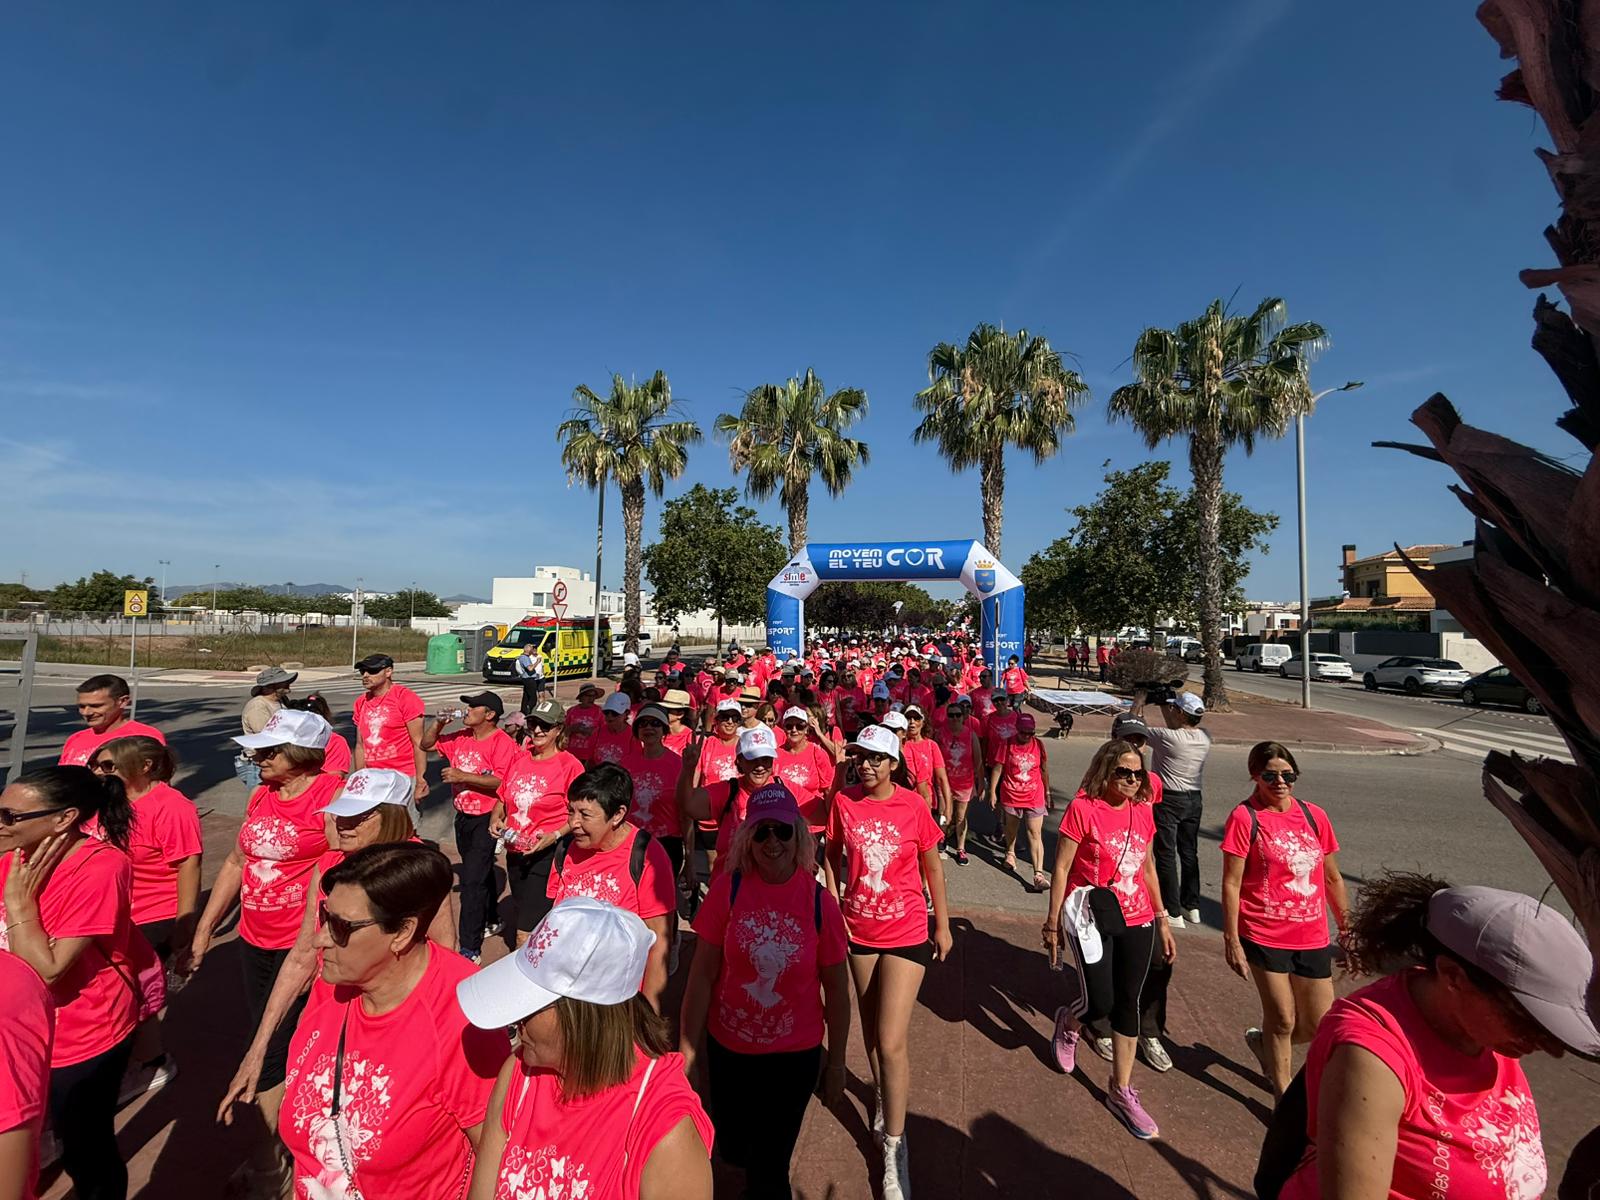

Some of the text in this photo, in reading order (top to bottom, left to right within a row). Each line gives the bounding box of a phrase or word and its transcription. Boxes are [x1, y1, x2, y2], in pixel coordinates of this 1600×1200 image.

[829, 548, 883, 558] MOVEM
[886, 548, 945, 569] COR
[829, 559, 883, 569] EL TEU
[1432, 1130, 1453, 1170] Dons
[1430, 1171, 1450, 1193] les
